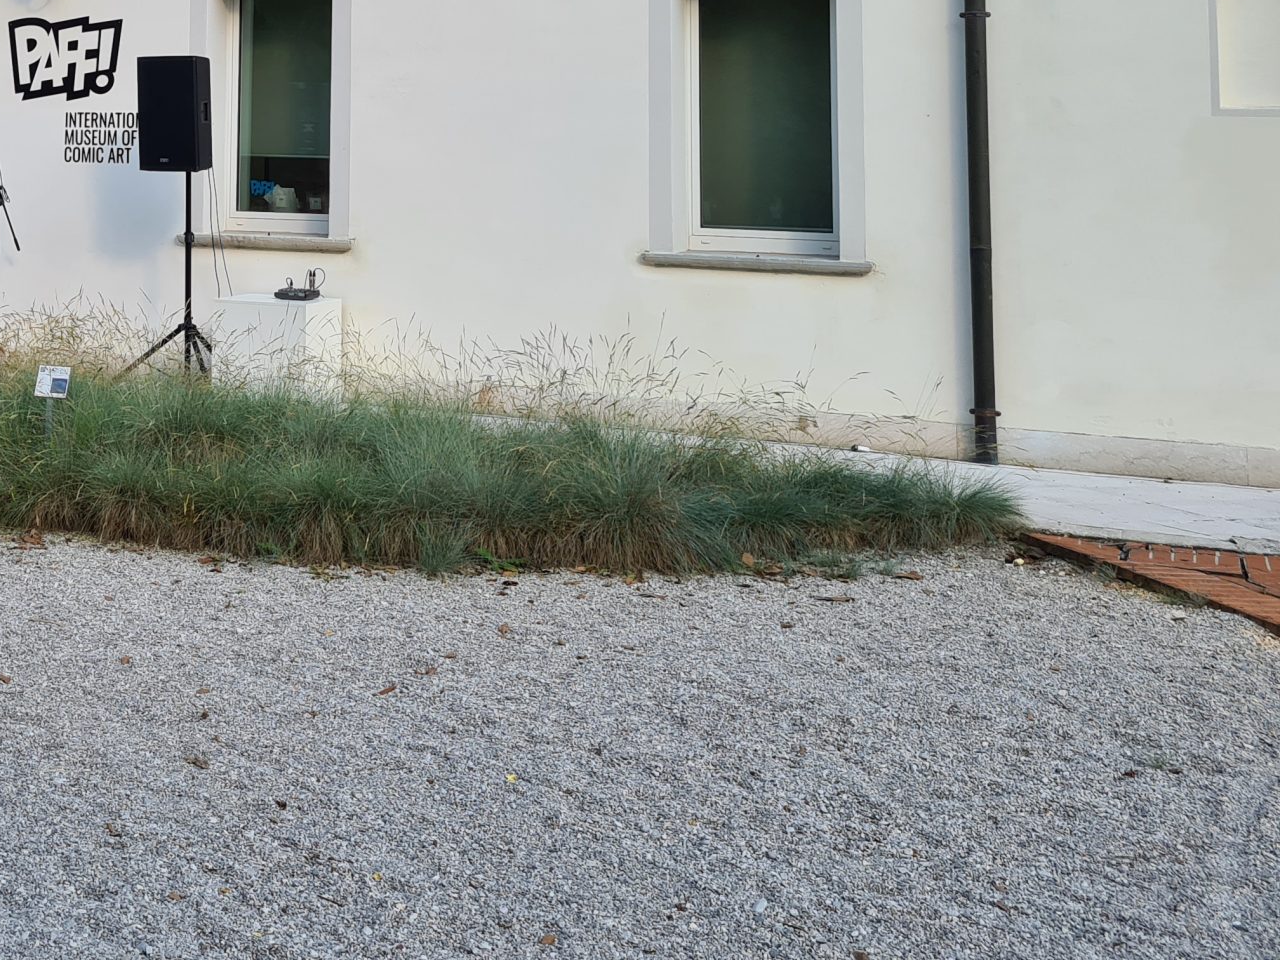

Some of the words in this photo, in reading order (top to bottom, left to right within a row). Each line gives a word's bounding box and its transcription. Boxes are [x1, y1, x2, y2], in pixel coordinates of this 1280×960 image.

[8, 16, 123, 101] PAFF!
[64, 129, 118, 146] MUSEUM
[122, 129, 138, 147] OF
[64, 146, 104, 164] COMIC
[108, 147, 132, 164] ART
